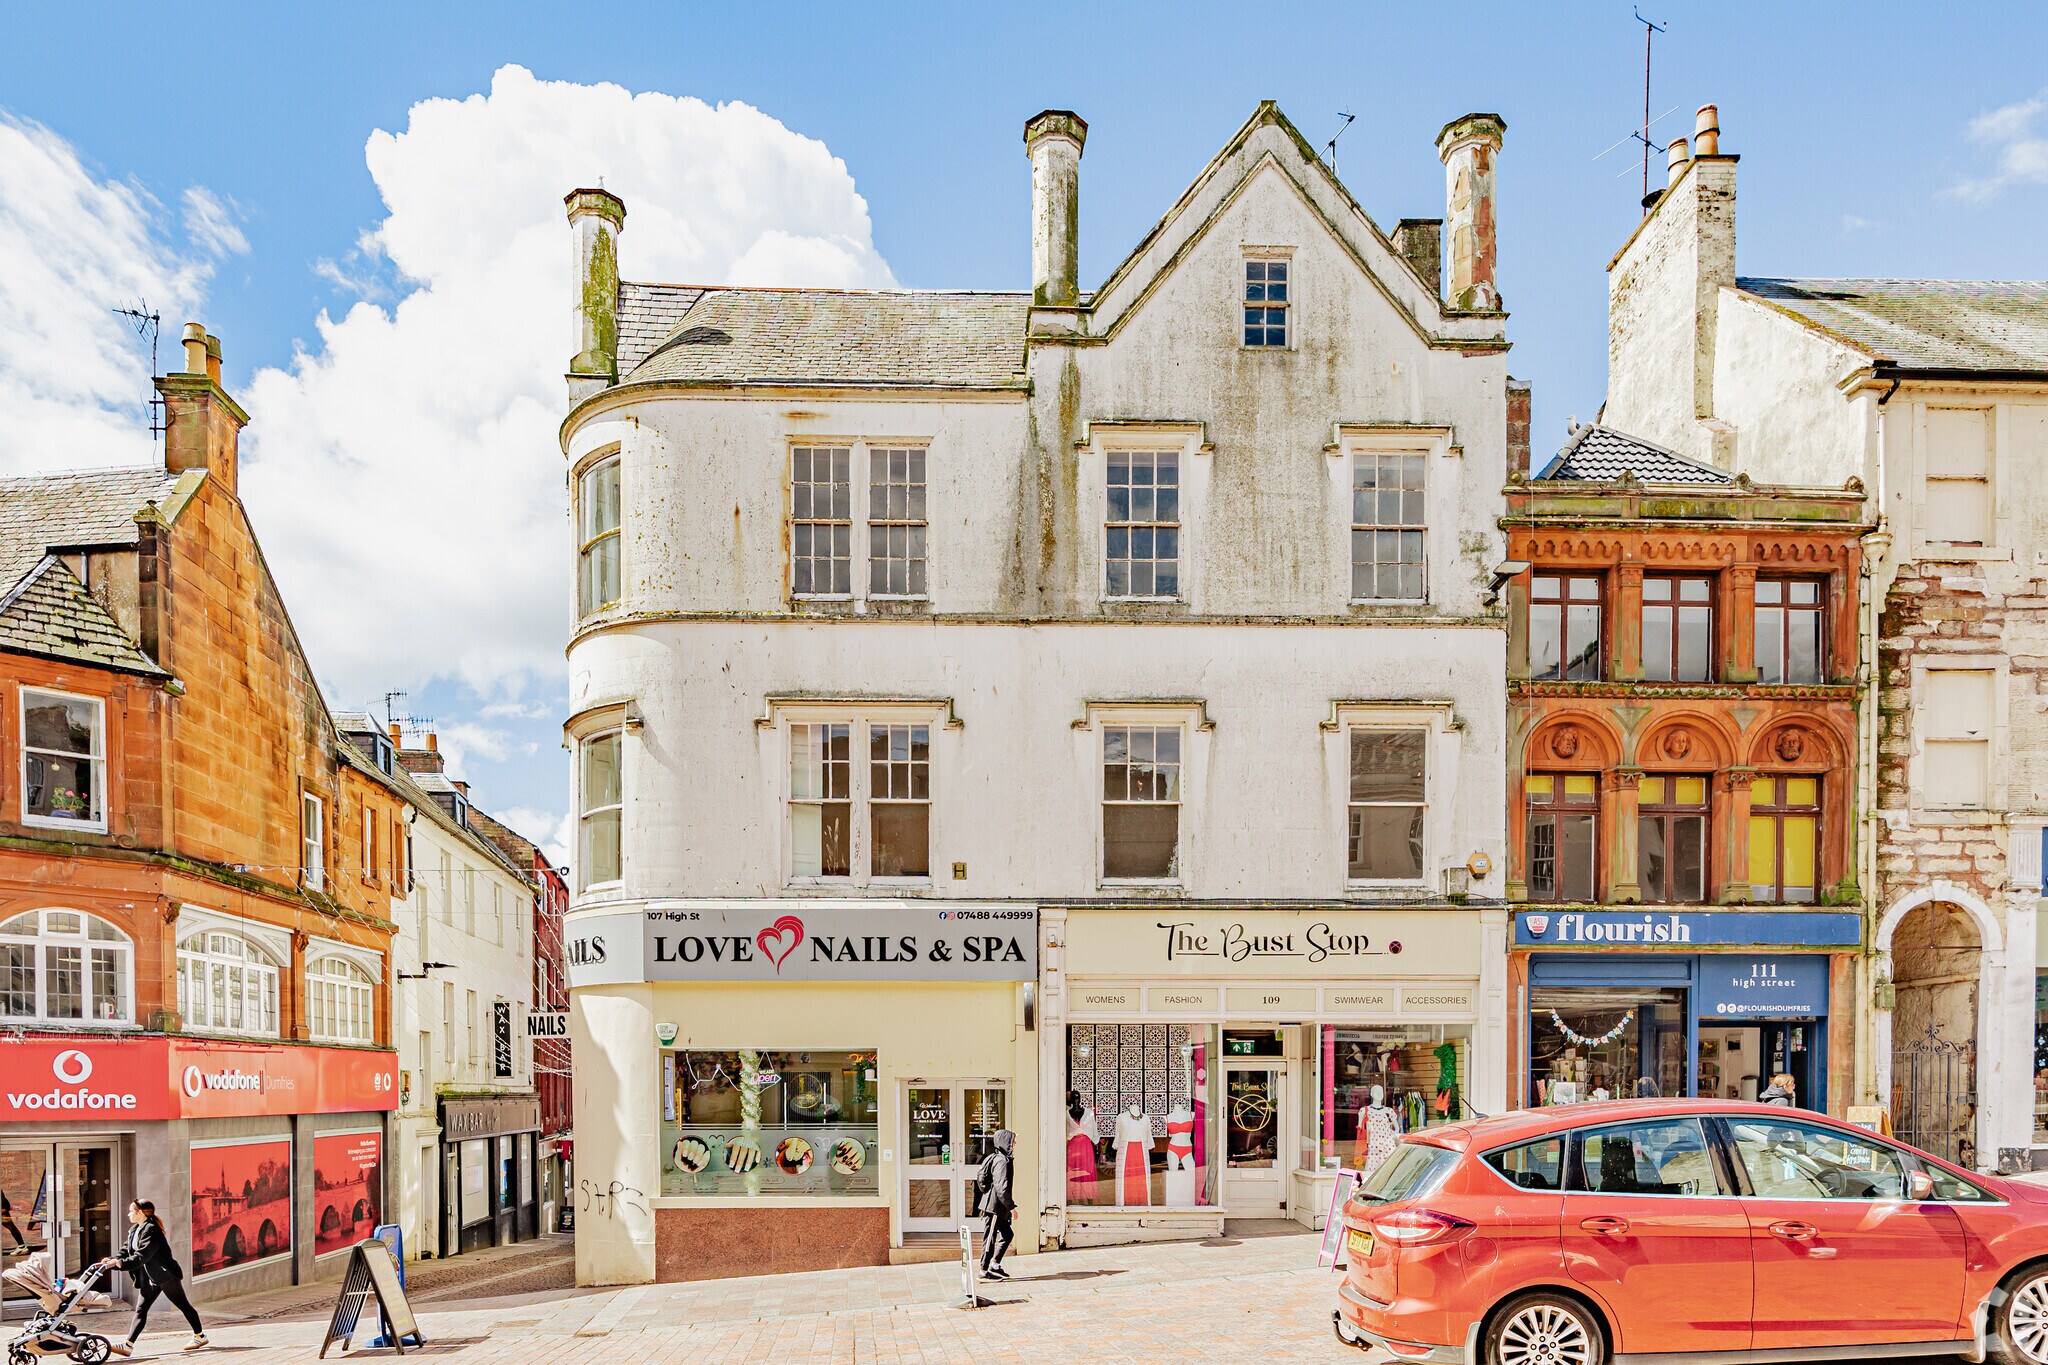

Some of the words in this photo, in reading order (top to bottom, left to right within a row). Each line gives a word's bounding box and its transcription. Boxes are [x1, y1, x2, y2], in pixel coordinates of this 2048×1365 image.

[954, 864, 965, 877] H
[647, 912, 662, 920] 107
[666, 912, 687, 922] High
[690, 912, 700, 920] St
[957, 911, 990, 920] 07488
[992, 911, 1034, 920] 449999
[1533, 917, 1544, 925] ASL
[1556, 914, 1691, 942] flourish
[1157, 922, 1208, 961] The
[1220, 923, 1295, 962] Bust
[1306, 922, 1370, 963] Stop
[654, 936, 753, 962] LOVE
[810, 936, 917, 962] NAILS
[929, 939, 952, 962] &
[963, 936, 1026, 962] SPA
[1751, 964, 1777, 978] 111
[1732, 978, 1756, 988] high
[1761, 979, 1796, 987] street
[1085, 996, 1125, 1004] WOMENS
[1164, 996, 1202, 1004] FASHION
[1262, 996, 1280, 1004] 109
[1334, 996, 1384, 1004] SWIMWEAR
[1405, 996, 1467, 1004] ACCESSORIES
[1737, 1004, 1811, 1013] @FLOURISHDUMFRIES
[527, 1015, 566, 1036] NAILS
[202, 1068, 260, 1090] vodafone
[266, 1075, 295, 1090] Dumfries
[753, 1073, 776, 1082] Open
[7, 1088, 137, 1109] vodafone
[913, 1110, 946, 1120] LOVE
[450, 1114, 468, 1132] WAX
[469, 1113, 483, 1131] BAR
